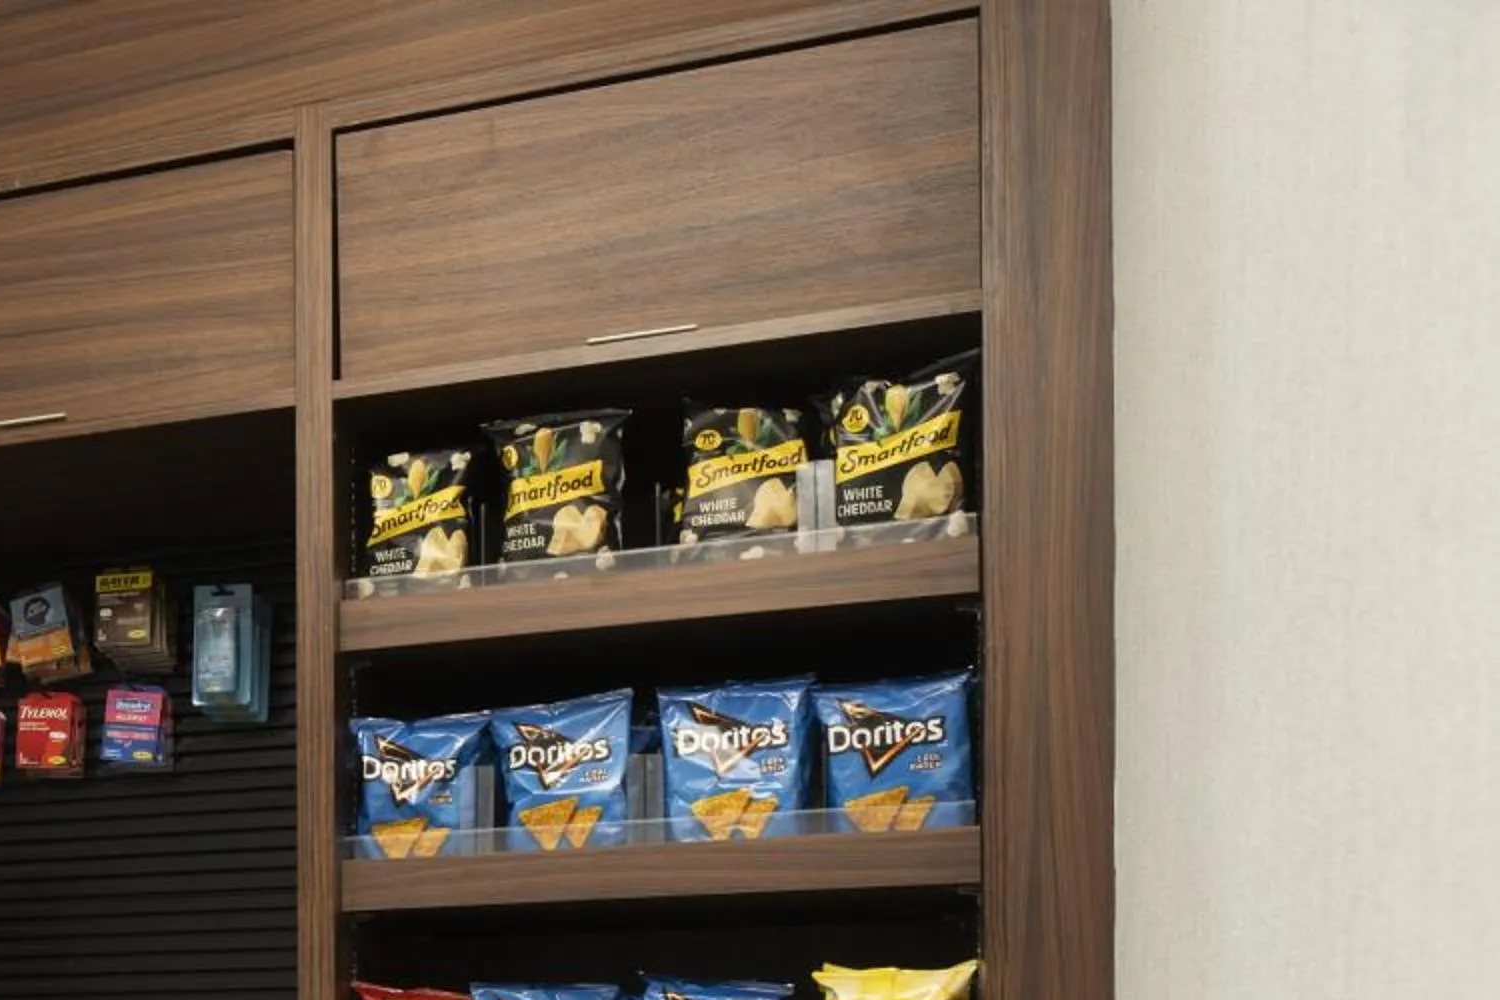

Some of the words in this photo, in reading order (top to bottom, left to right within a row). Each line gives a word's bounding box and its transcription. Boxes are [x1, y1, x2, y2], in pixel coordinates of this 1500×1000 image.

[840, 422, 952, 473] Smartfood
[696, 446, 802, 488] Smartfood
[511, 471, 593, 504] martfood
[843, 485, 884, 502] WHITE
[372, 496, 460, 539] Smartfood
[691, 511, 746, 527] CHEDDAR
[699, 497, 738, 513] WHITE
[837, 500, 893, 518] CHEDDAR
[375, 547, 407, 562] WHITE
[20, 706, 69, 719] TYLENOL
[677, 725, 788, 755] Doritos
[828, 718, 945, 752] Doritos
[509, 738, 610, 769] Doritos
[361, 756, 456, 783] Doritos
